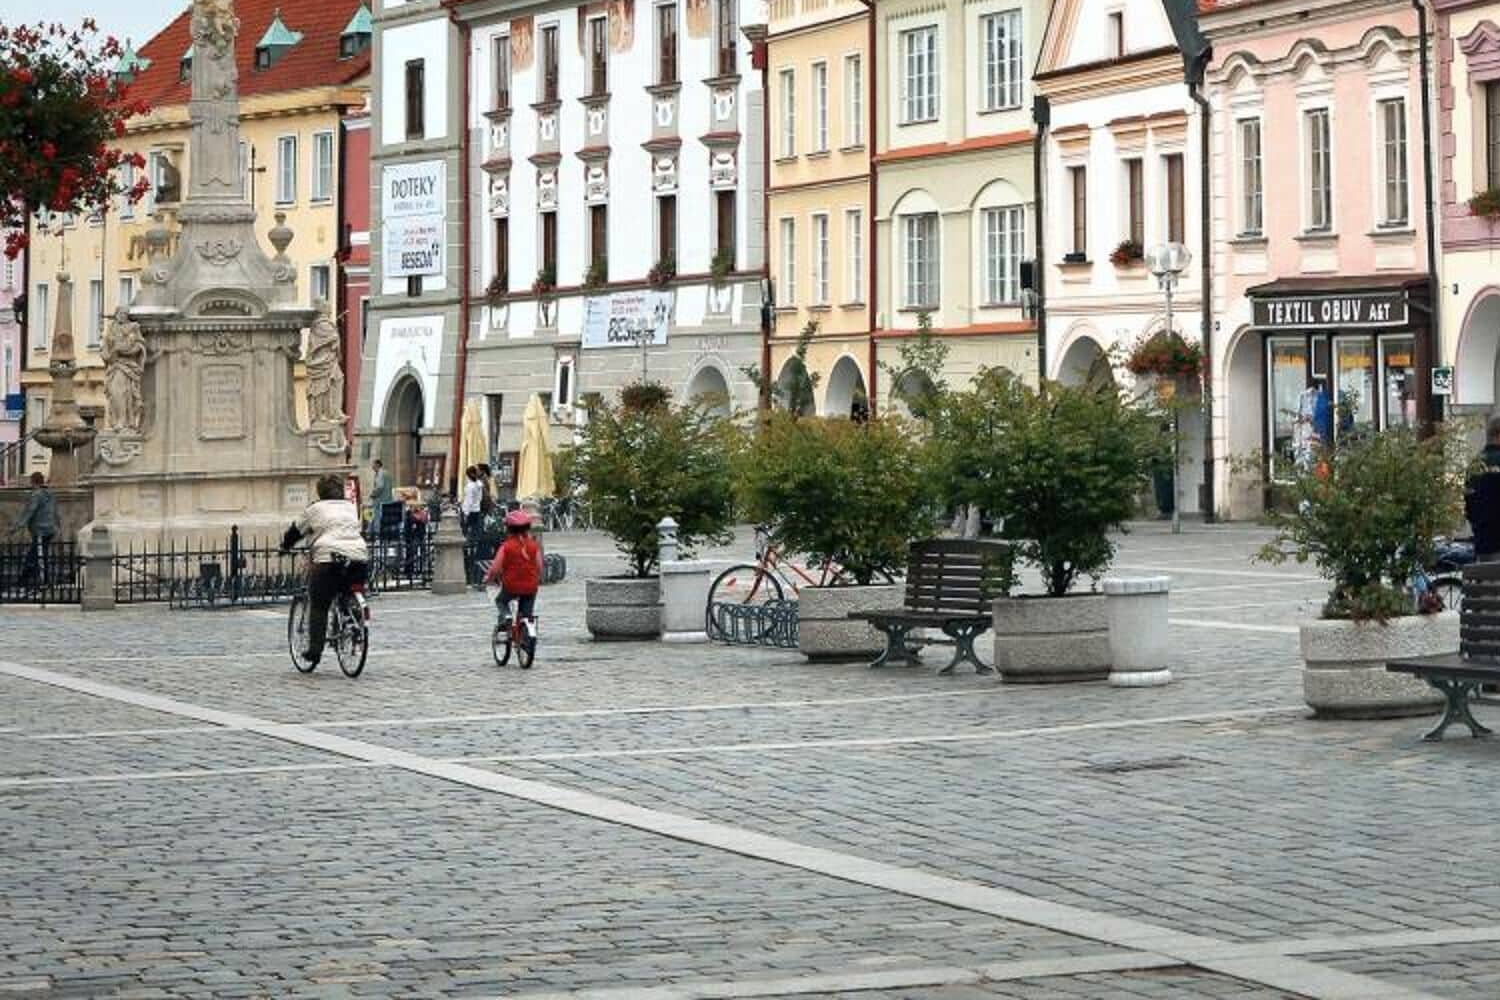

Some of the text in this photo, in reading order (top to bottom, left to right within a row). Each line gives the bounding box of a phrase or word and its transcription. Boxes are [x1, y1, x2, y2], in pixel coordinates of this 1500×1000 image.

[391, 175, 437, 199] DOTEKY
[1268, 301, 1315, 324] TEXTIL
[1321, 299, 1362, 323] OBUV
